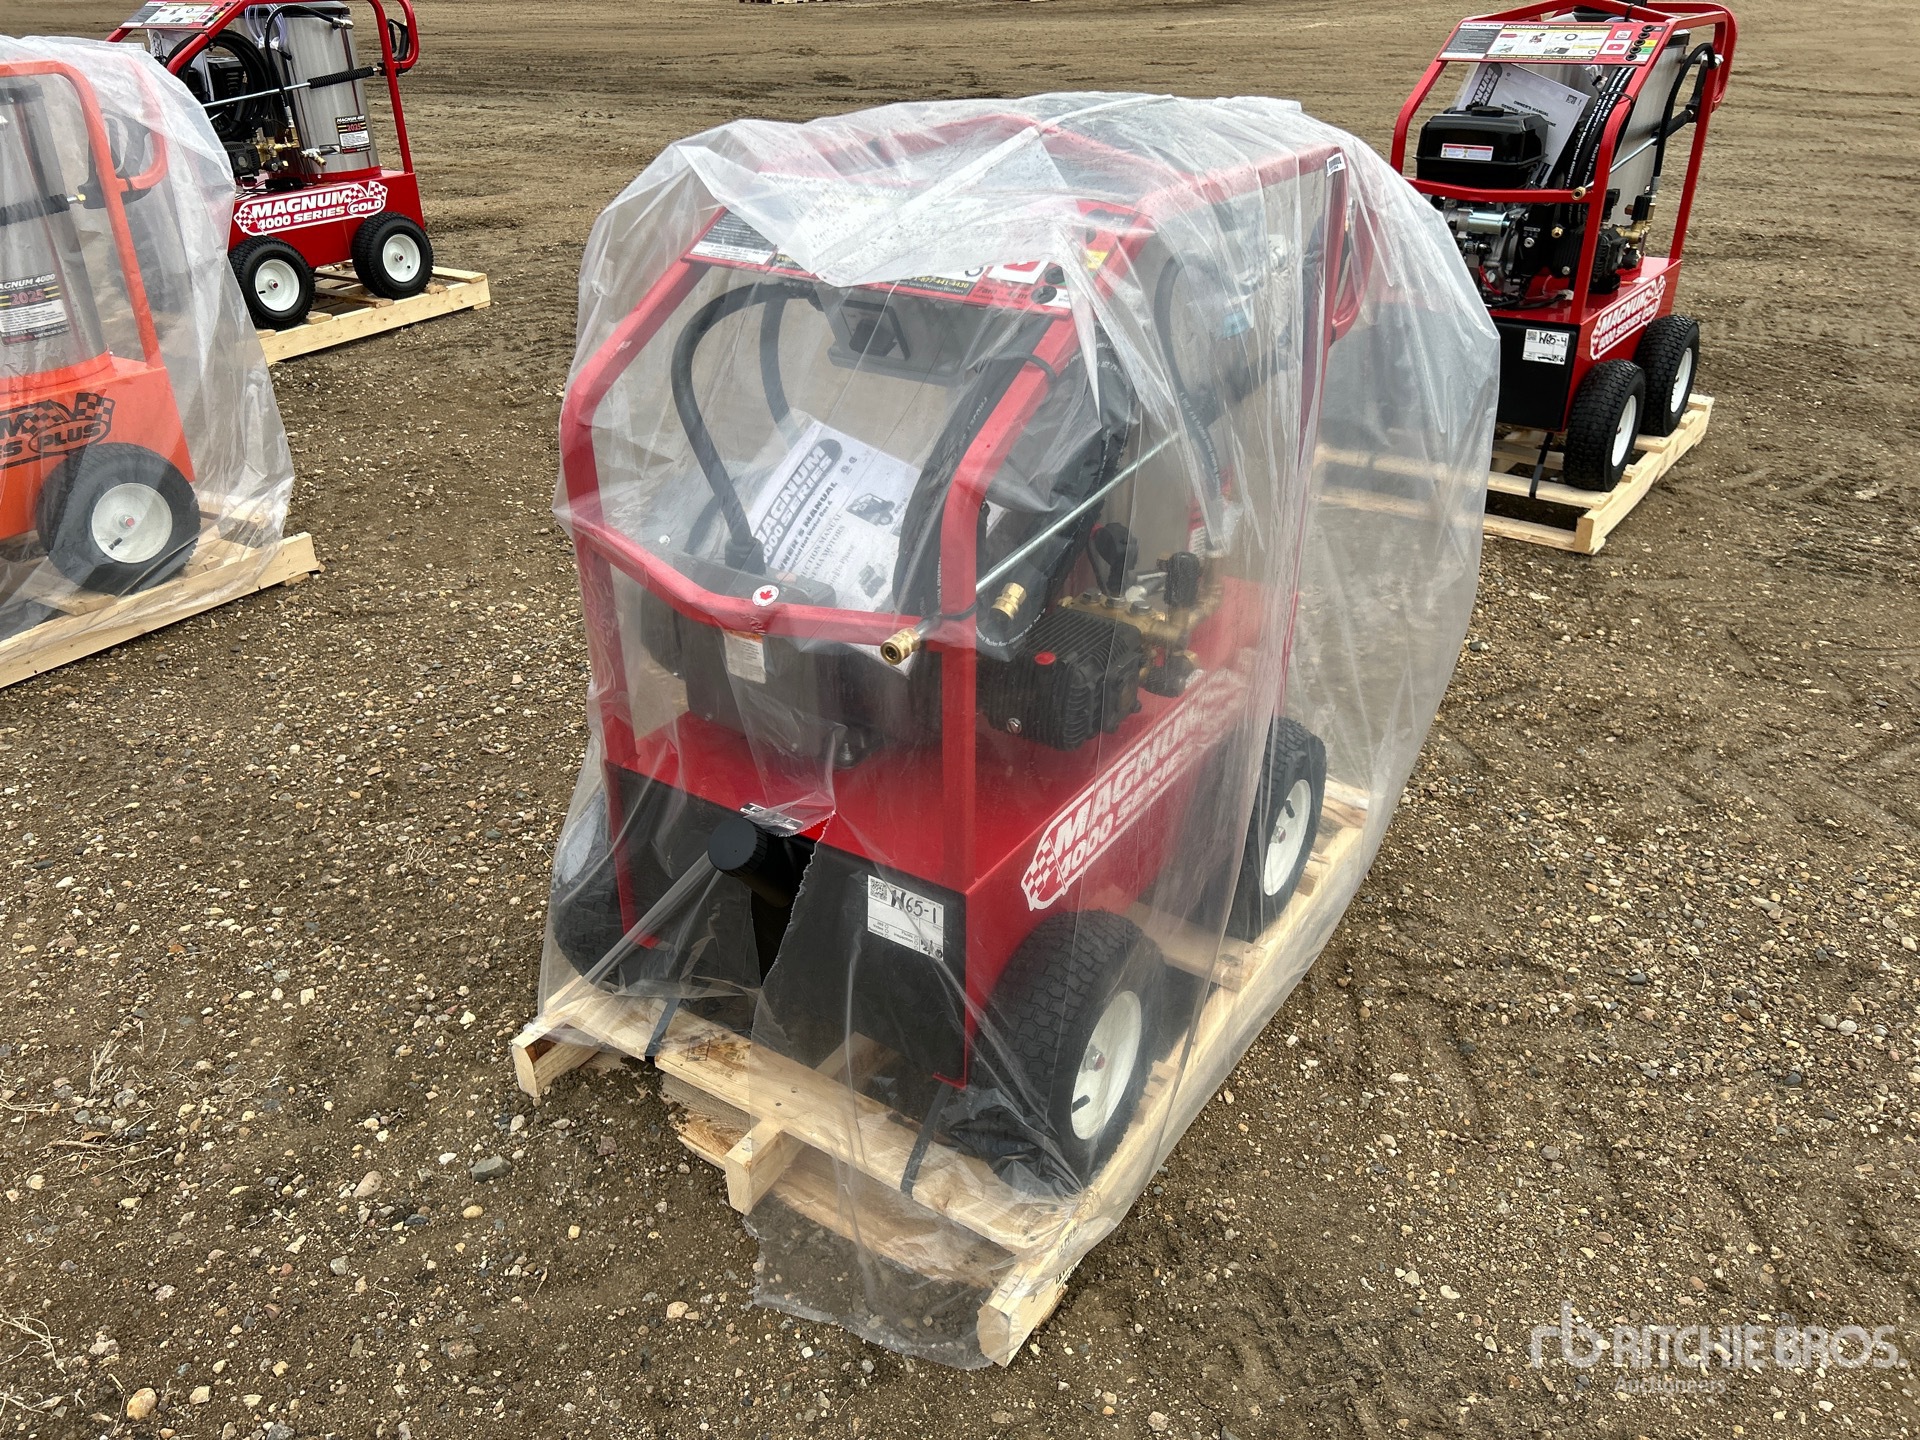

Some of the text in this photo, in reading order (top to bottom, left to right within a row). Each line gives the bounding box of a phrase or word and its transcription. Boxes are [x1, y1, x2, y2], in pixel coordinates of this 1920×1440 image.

[251, 189, 351, 218] MAGNUM
[257, 206, 345, 230] 4000 SERIES
[349, 200, 382, 214] GOLD
[0, 273, 56, 290] AGNUM 4000
[11, 288, 45, 306] 2025
[1600, 290, 1647, 335] MAGNUM
[38, 422, 101, 450] PLUS
[781, 455, 833, 528] SERIES
[803, 481, 838, 529] MANUAL
[805, 516, 822, 537] Water
[817, 510, 844, 545] MANUAL
[819, 523, 846, 559] MOTORS
[1056, 813, 1114, 883] 4000
